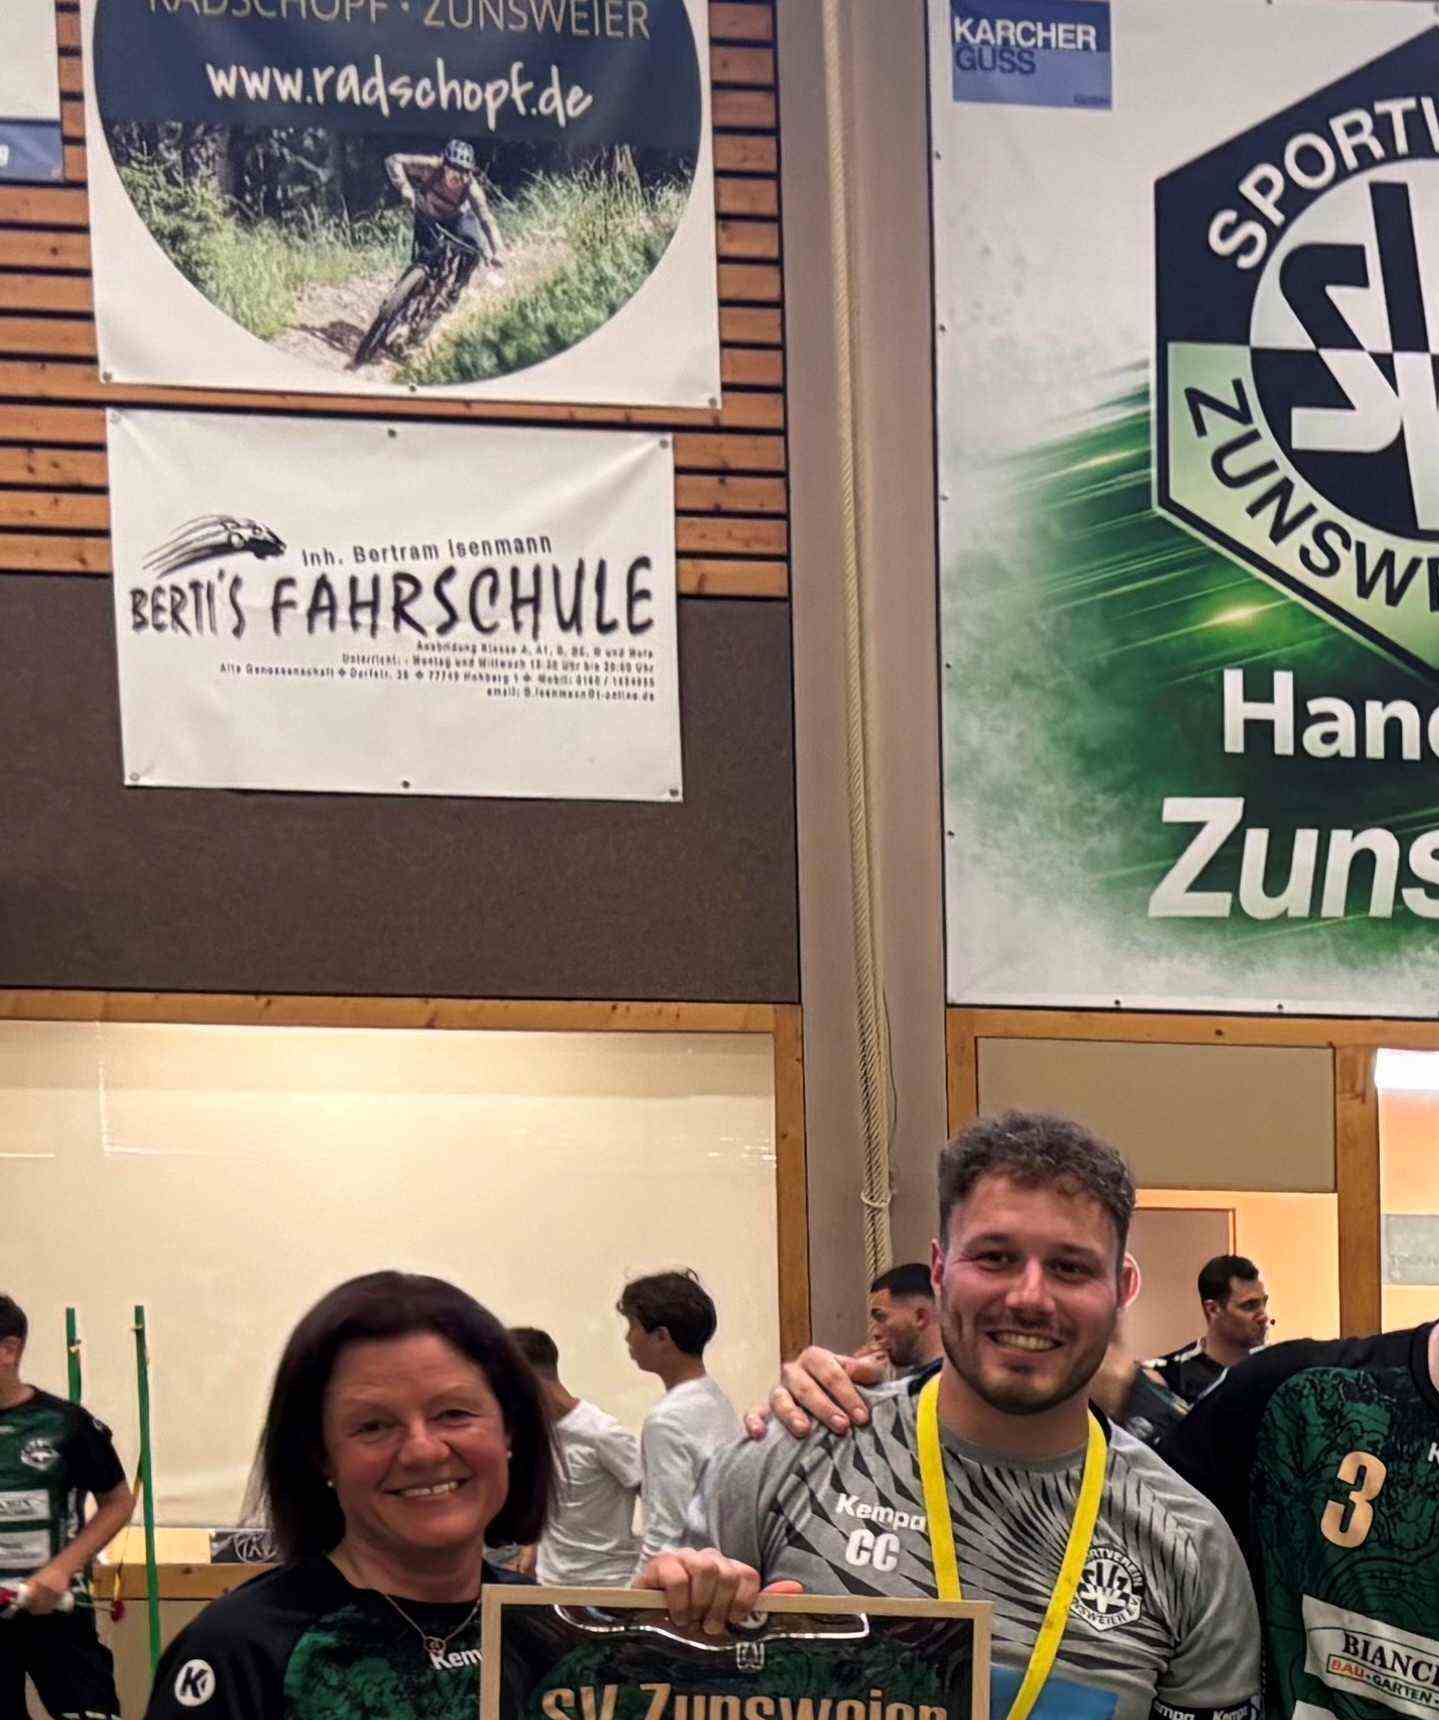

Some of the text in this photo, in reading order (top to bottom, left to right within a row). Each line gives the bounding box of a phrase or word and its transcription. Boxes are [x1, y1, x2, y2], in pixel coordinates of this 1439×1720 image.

[423, 0, 650, 39] ZUNSWEIER
[953, 17, 1096, 50] KARCHER
[955, 48, 1036, 75] GUSS
[206, 54, 593, 131] www.radschopf.de
[302, 535, 552, 567] Inh. Bertram Isenmann
[130, 556, 654, 641] BERTI'S FAHRSCHULE
[836, 1493, 927, 1532] Kempa
[1320, 1450, 1387, 1548] 3
[845, 1528, 900, 1572] CC
[429, 1645, 481, 1672] Kem
[1372, 1674, 1433, 1703] GARTEN
